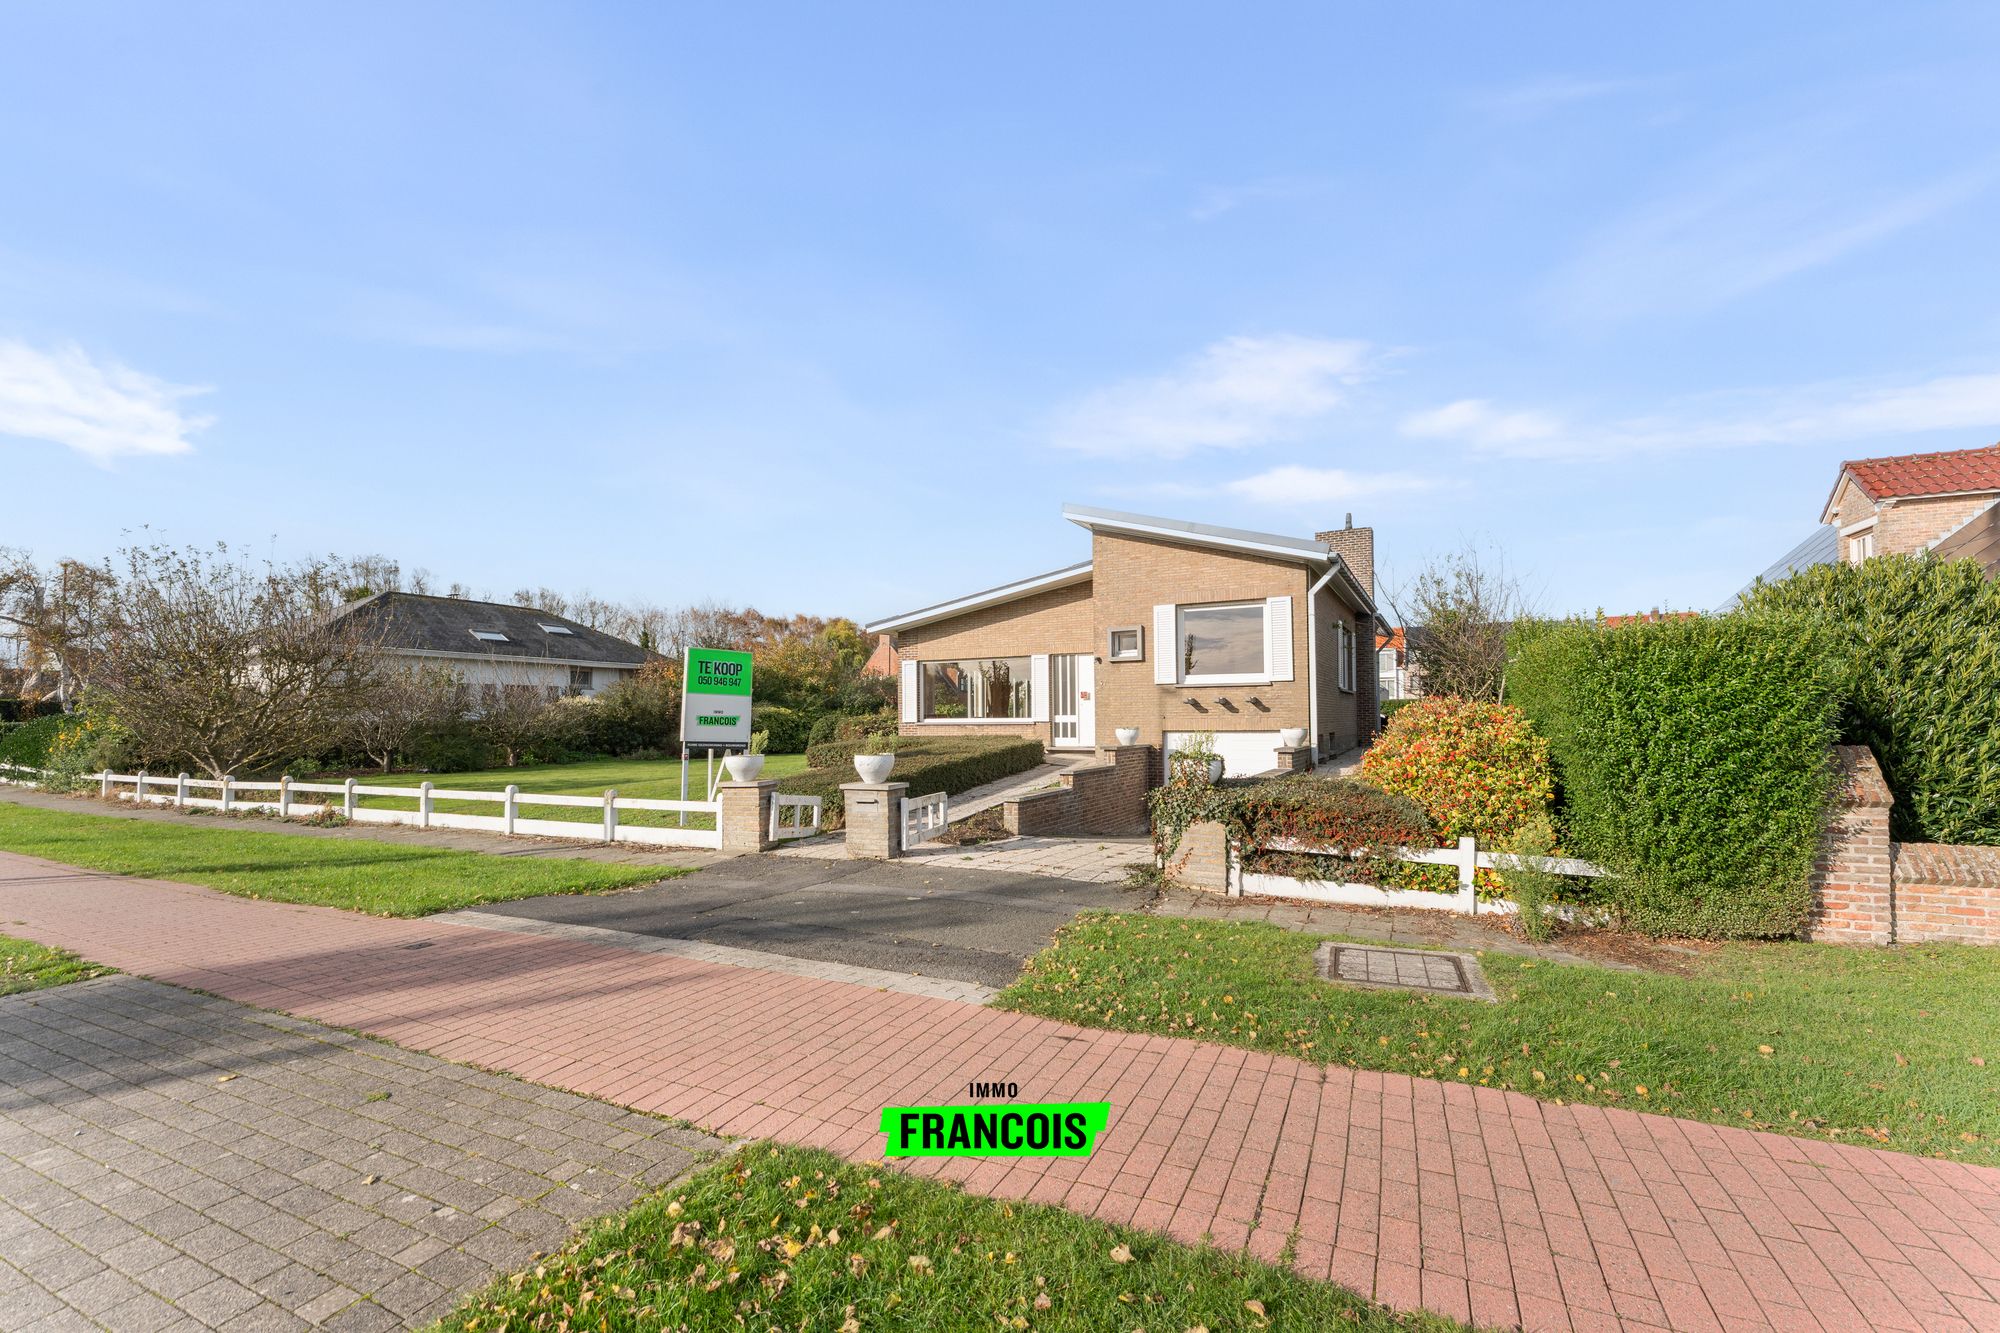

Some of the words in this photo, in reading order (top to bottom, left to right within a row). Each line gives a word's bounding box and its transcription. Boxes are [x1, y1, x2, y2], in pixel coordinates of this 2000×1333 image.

[698, 661, 711, 674] TE
[714, 662, 742, 676] KOOP
[698, 676, 712, 685] 050
[713, 676, 728, 686] 946
[729, 677, 741, 687] 947
[699, 716, 737, 726] FRANCOIS
